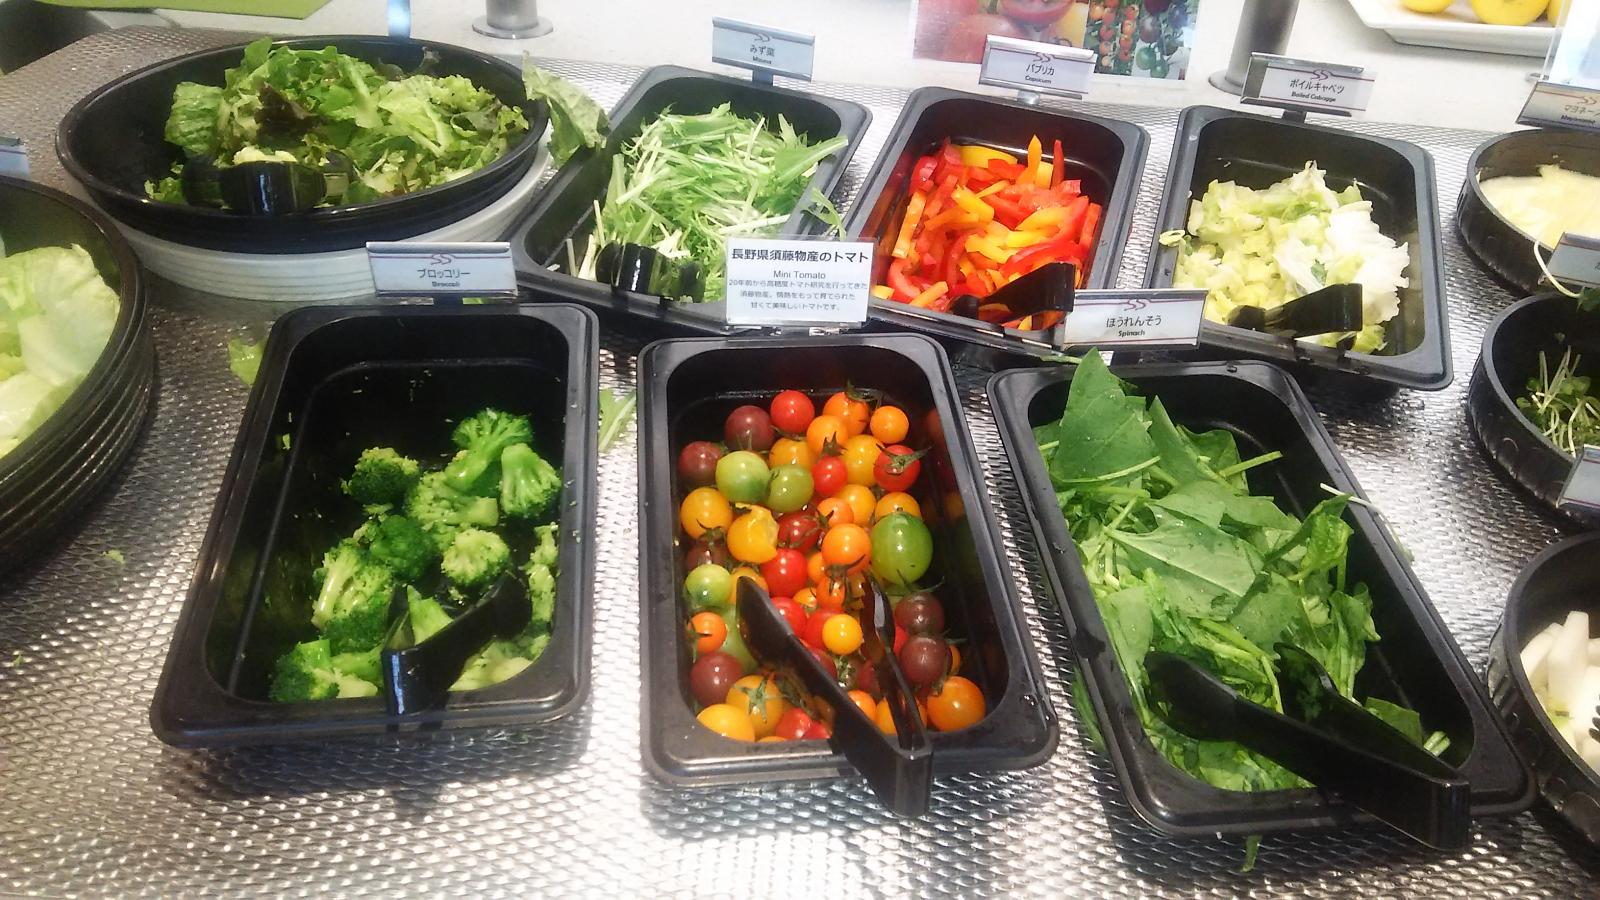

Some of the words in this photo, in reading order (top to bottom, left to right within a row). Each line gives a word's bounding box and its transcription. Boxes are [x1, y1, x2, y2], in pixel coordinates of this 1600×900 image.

[1290, 78, 1344, 94] ボイルキャベツ
[1564, 104, 1600, 116] マヨネー
[732, 248, 869, 264] 長野県須藤物産のトマト
[417, 267, 472, 279] ブロッコリー
[773, 270, 791, 279] Mini
[794, 271, 826, 280] Tomato
[1106, 315, 1162, 328] ほうれんそう
[1118, 329, 1146, 338] Spinach
